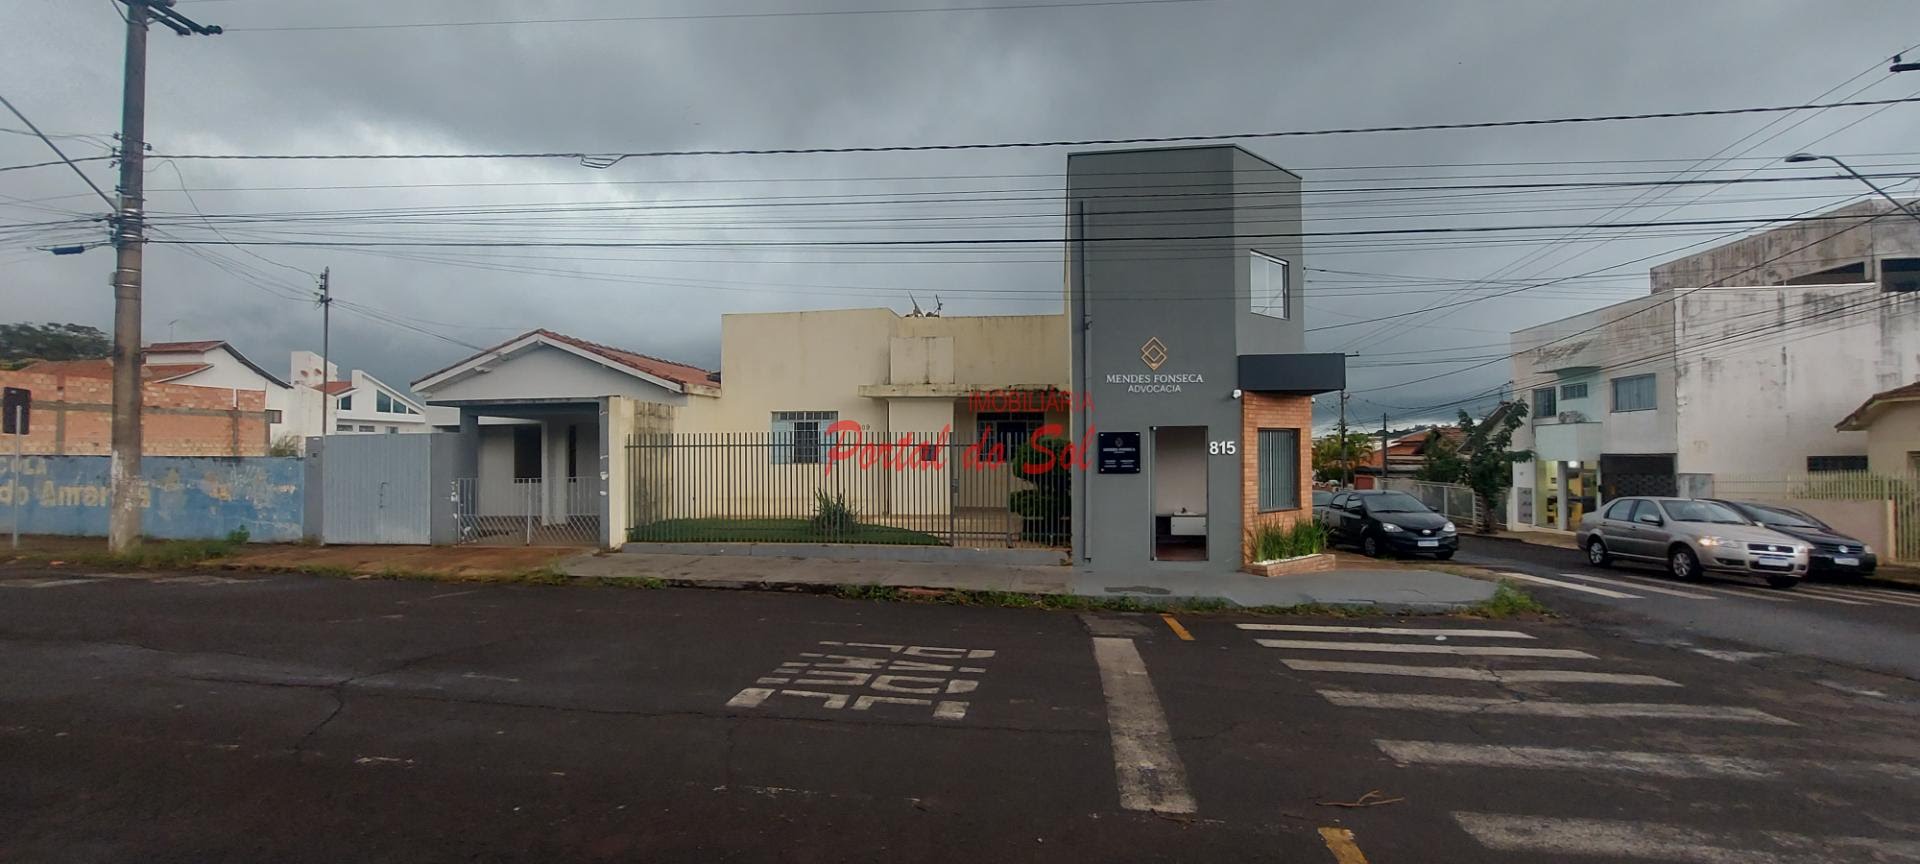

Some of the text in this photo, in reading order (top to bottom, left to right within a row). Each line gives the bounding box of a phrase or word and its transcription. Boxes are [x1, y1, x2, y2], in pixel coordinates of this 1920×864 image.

[1106, 373, 1204, 384] MENDES FONSECA
[1127, 384, 1182, 393] ADVOCACIA
[1209, 440, 1237, 455] 815
